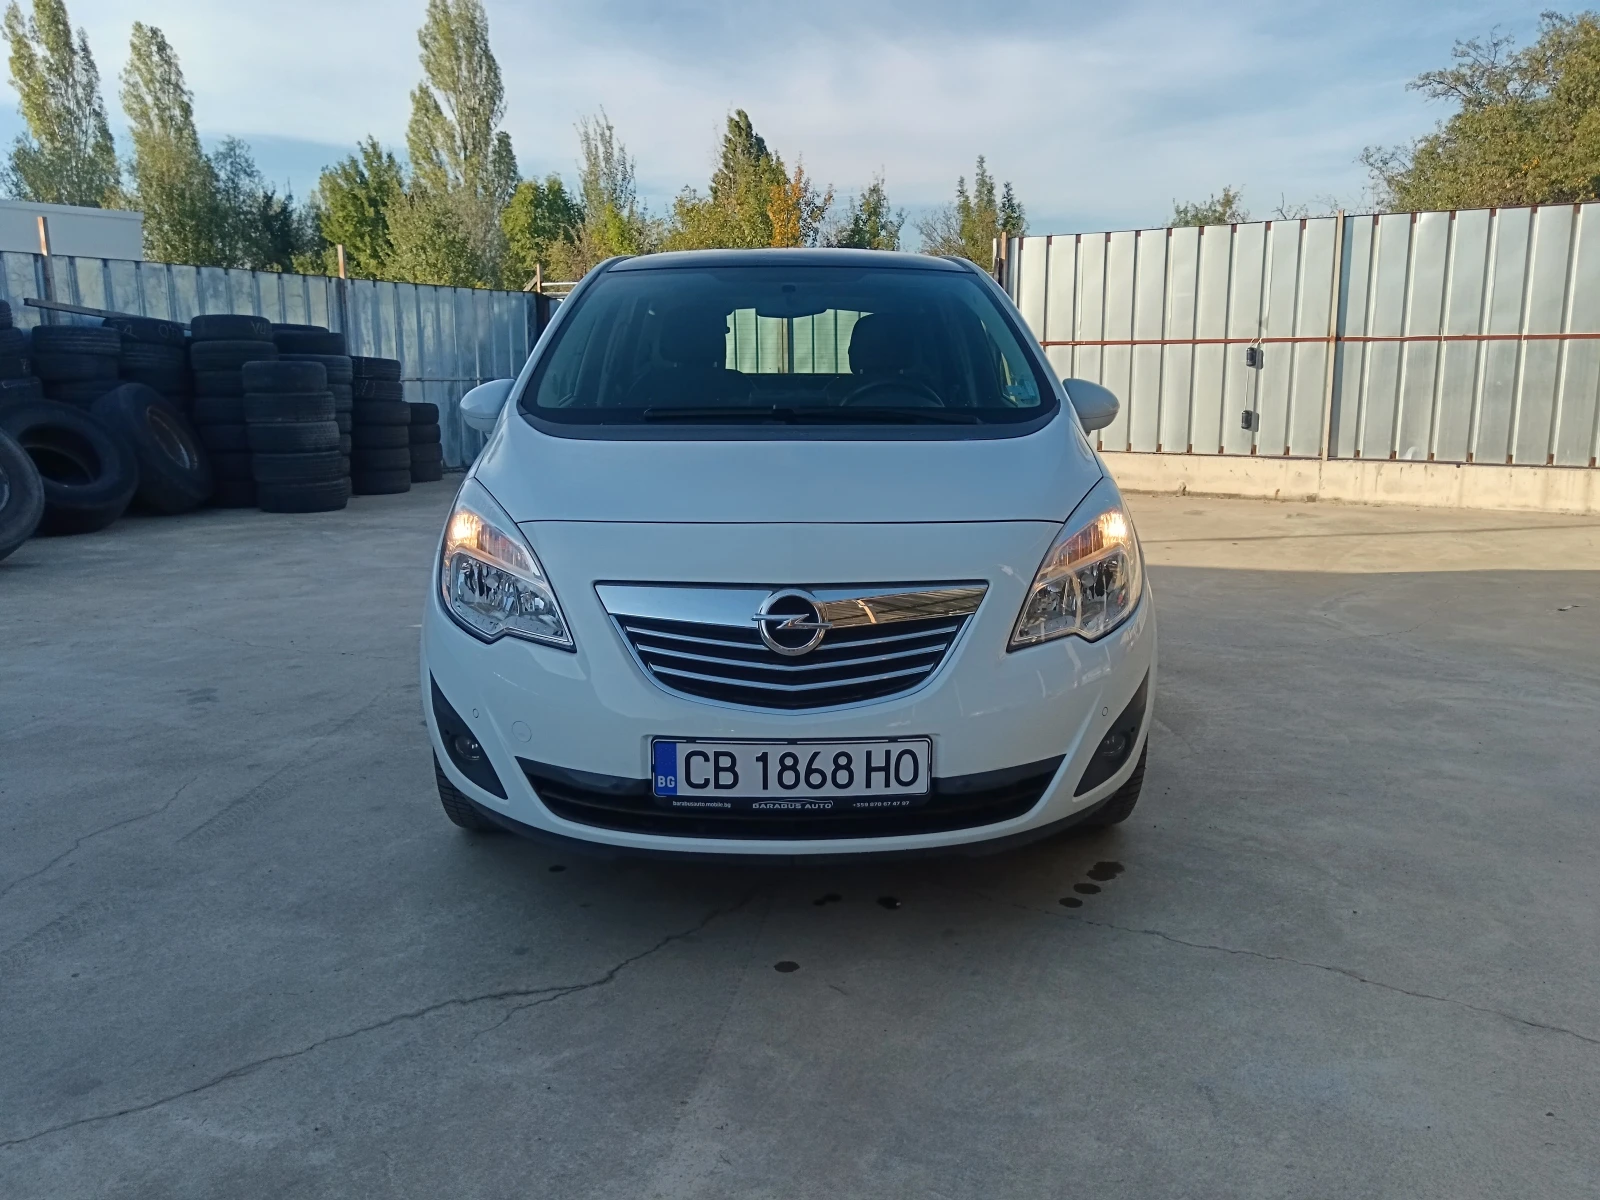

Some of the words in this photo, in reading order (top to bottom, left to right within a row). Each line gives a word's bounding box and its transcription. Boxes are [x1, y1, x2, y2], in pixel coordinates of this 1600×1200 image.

[657, 776, 676, 788] BG
[684, 750, 740, 790] CB
[755, 751, 855, 790] 1868
[865, 748, 920, 789] HO
